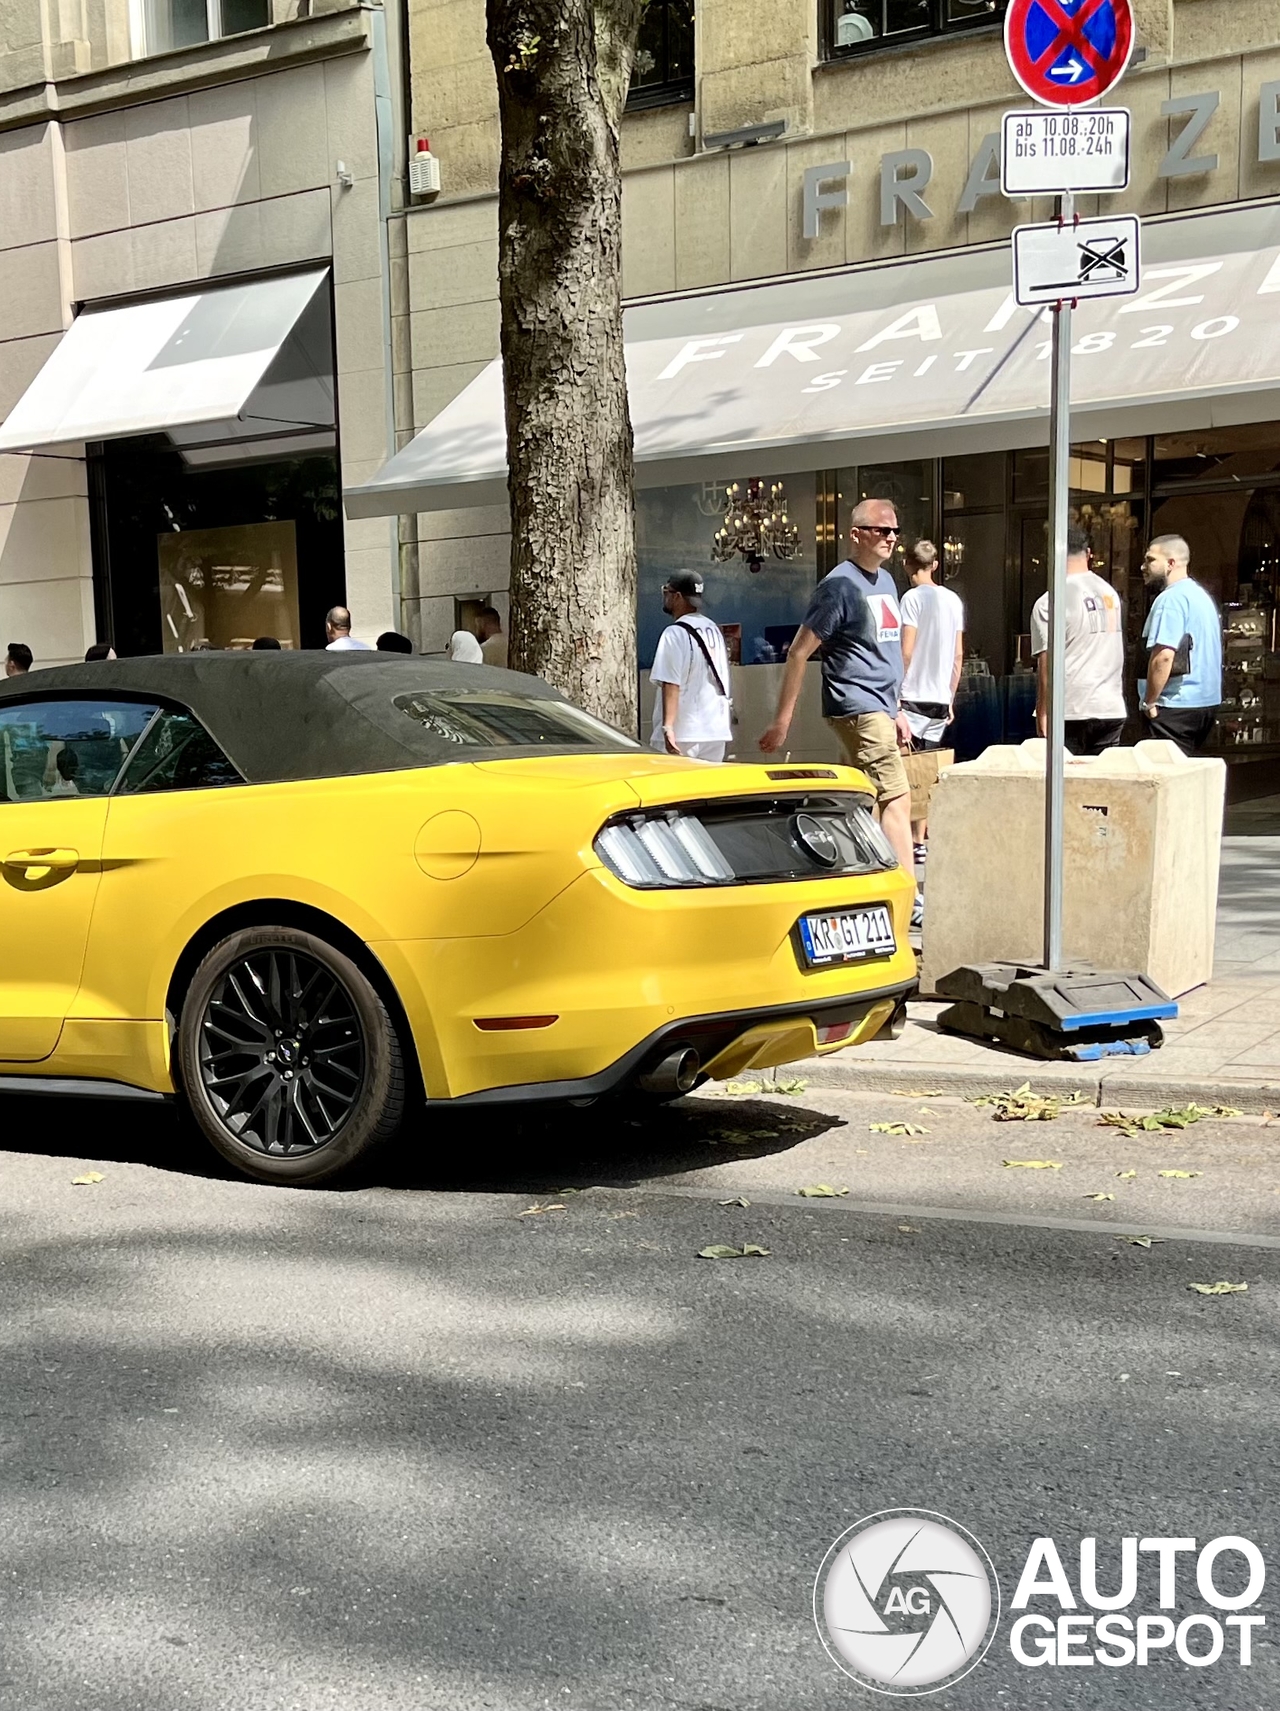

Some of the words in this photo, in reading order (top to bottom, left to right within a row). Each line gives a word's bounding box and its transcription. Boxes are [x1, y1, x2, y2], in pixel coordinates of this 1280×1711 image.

[1014, 138, 1037, 157] bis
[1015, 117, 1033, 138] ab
[803, 80, 1280, 239] FRAZE
[657, 254, 1280, 380] FRAZ
[801, 347, 993, 394] SEIT
[1034, 314, 1241, 361] 1820
[809, 918, 835, 951] KR
[840, 914, 861, 946] GT
[862, 910, 892, 943] 211
